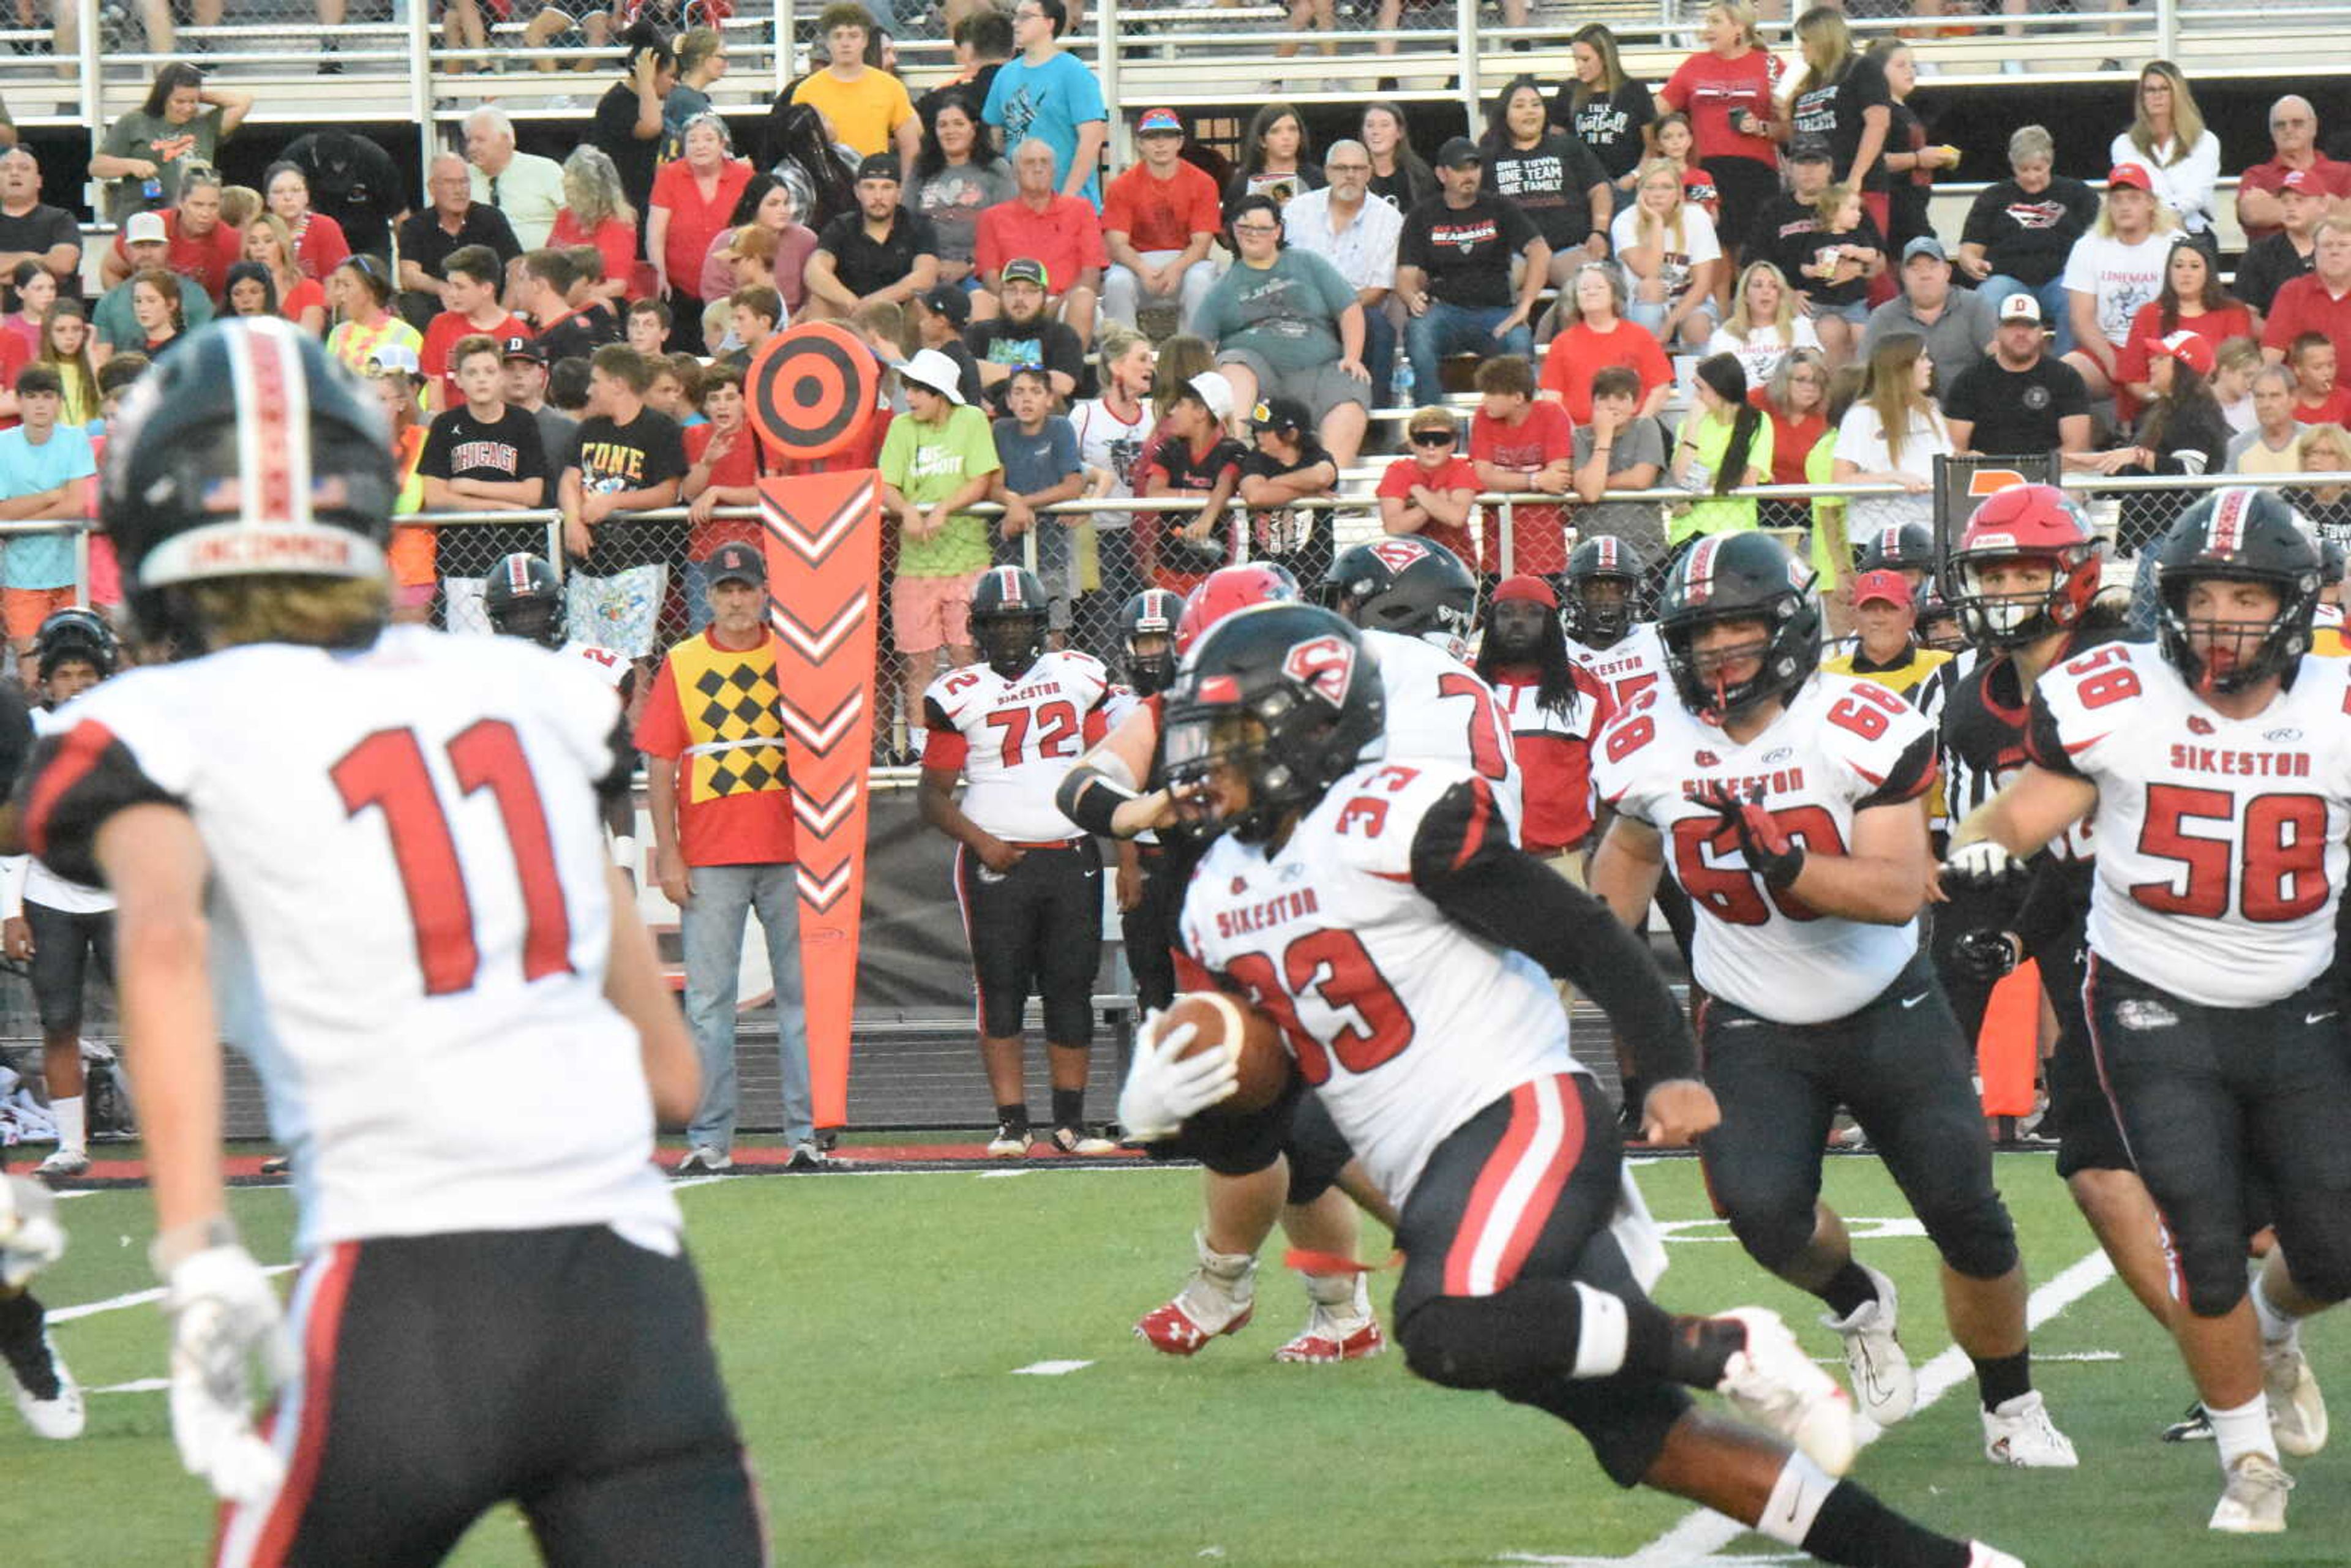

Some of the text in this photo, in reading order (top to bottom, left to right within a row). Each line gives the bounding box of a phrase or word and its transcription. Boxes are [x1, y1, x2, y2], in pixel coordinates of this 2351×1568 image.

[1587, 132, 1615, 144] TO ME
[1496, 156, 1561, 172] ONE TOWN
[1497, 165, 1562, 183] ONE TEAM
[1498, 179, 1563, 195] ONE FAMILY
[511, 337, 523, 351] D
[1587, 655, 1643, 677] KESTON
[2066, 645, 2143, 711] 58
[986, 699, 1080, 768] 72
[2170, 743, 2312, 778] SIKESTON
[329, 718, 576, 997] 11
[2129, 781, 2331, 923] 58
[1216, 887, 1319, 939] SIKESTON
